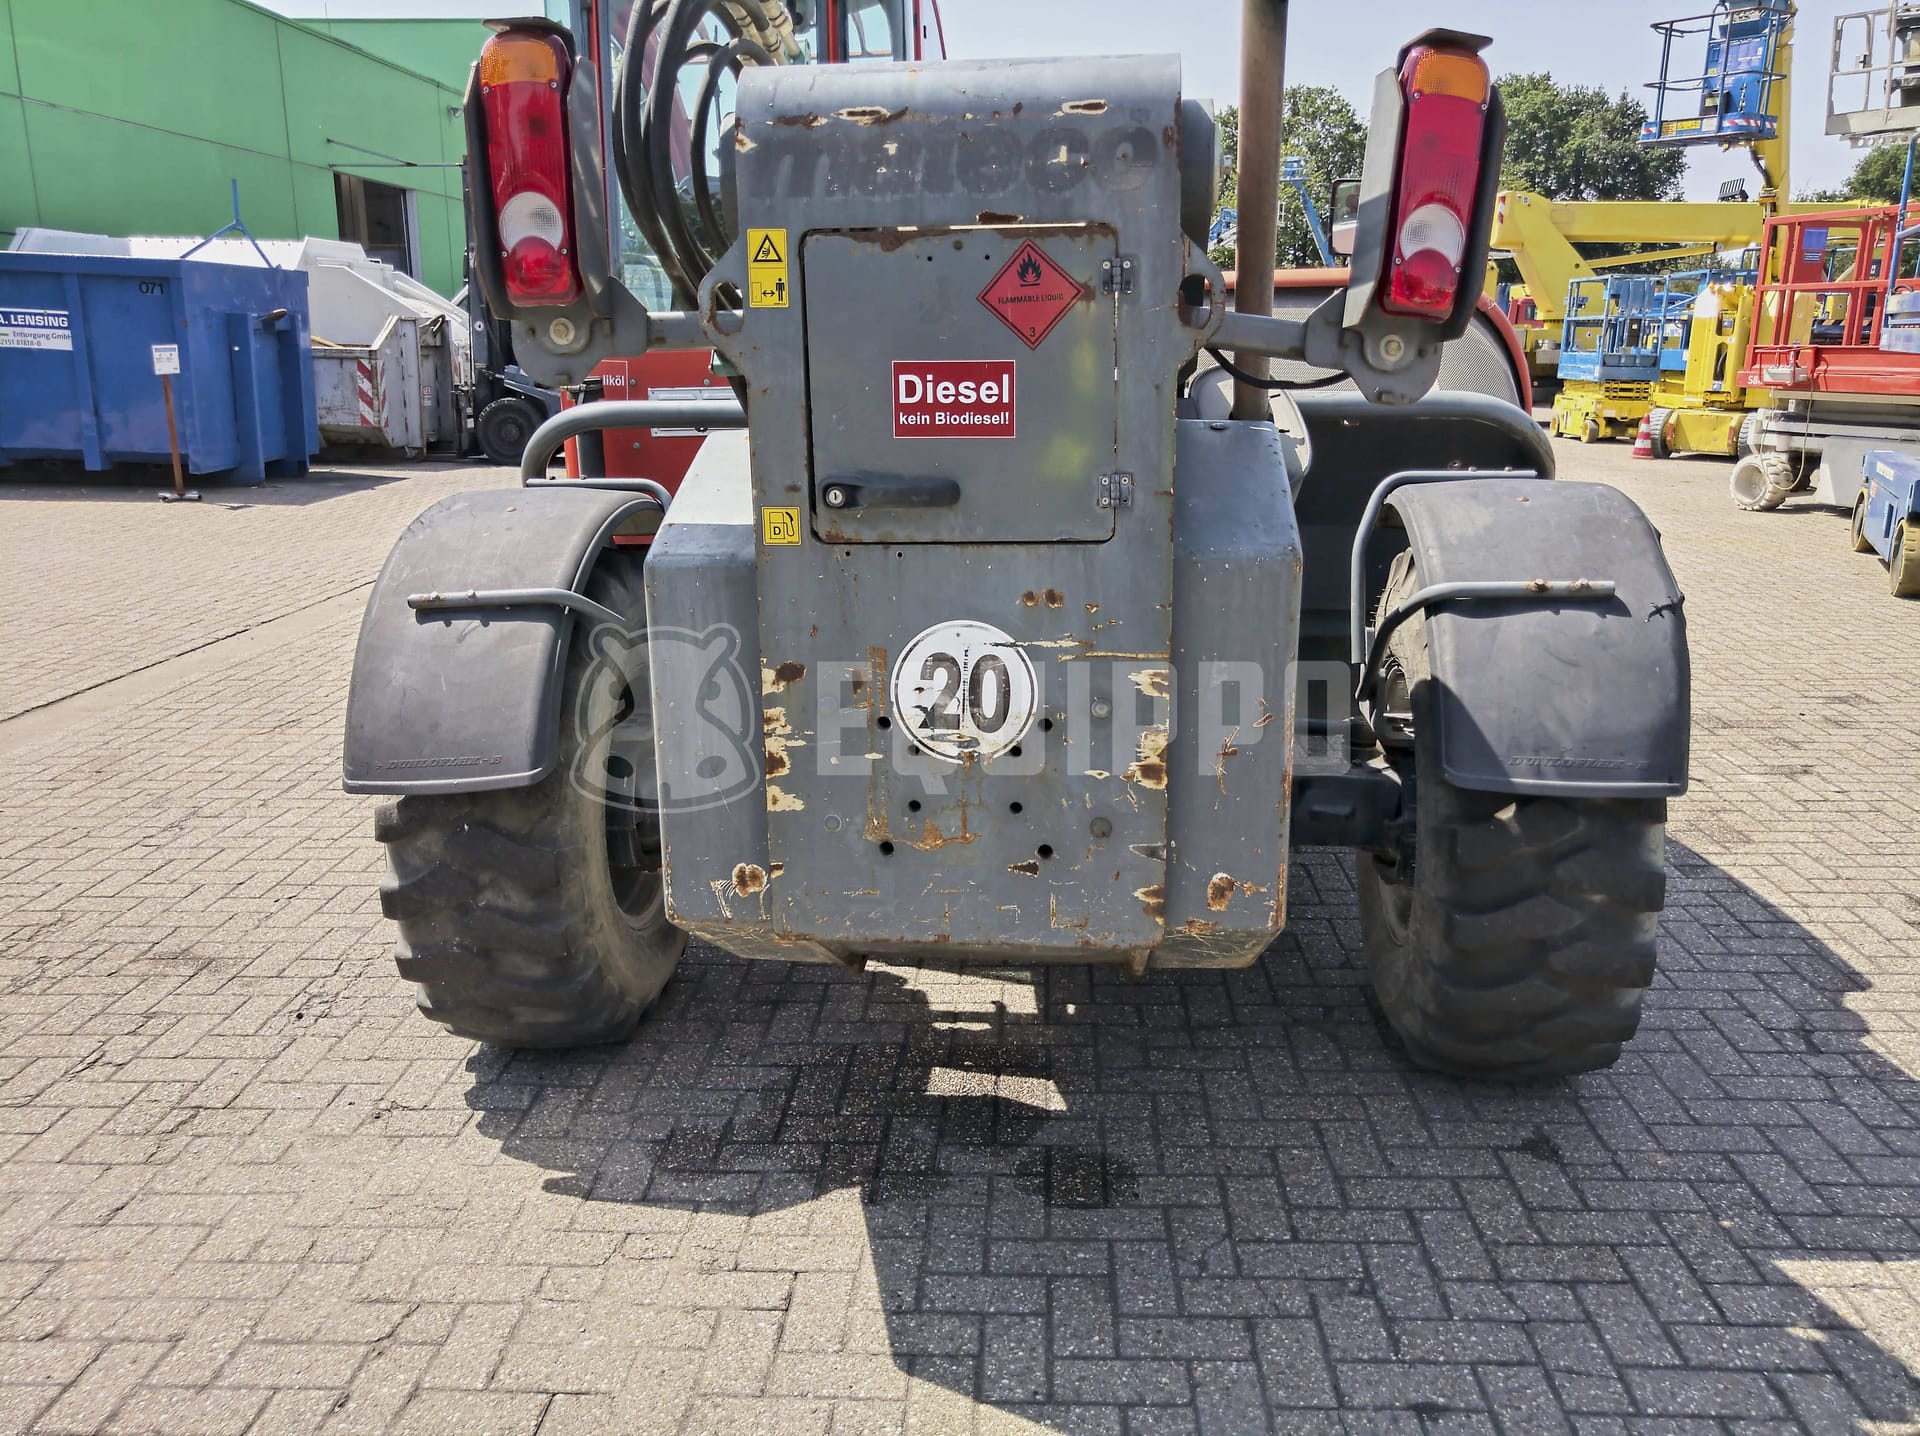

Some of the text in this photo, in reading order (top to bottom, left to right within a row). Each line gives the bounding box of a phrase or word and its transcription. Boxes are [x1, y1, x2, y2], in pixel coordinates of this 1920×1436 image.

[139, 281, 164, 295] 071
[998, 293, 1064, 304] FLAMMABLE LIQUID
[10, 314, 69, 328] LENSING
[12, 331, 51, 340] Entsorgung
[1029, 326, 1036, 337] 3
[898, 373, 1009, 404] Diesel
[899, 410, 1009, 425] kein Biodiesel!
[773, 526, 781, 536] D
[917, 652, 1012, 734] 20
